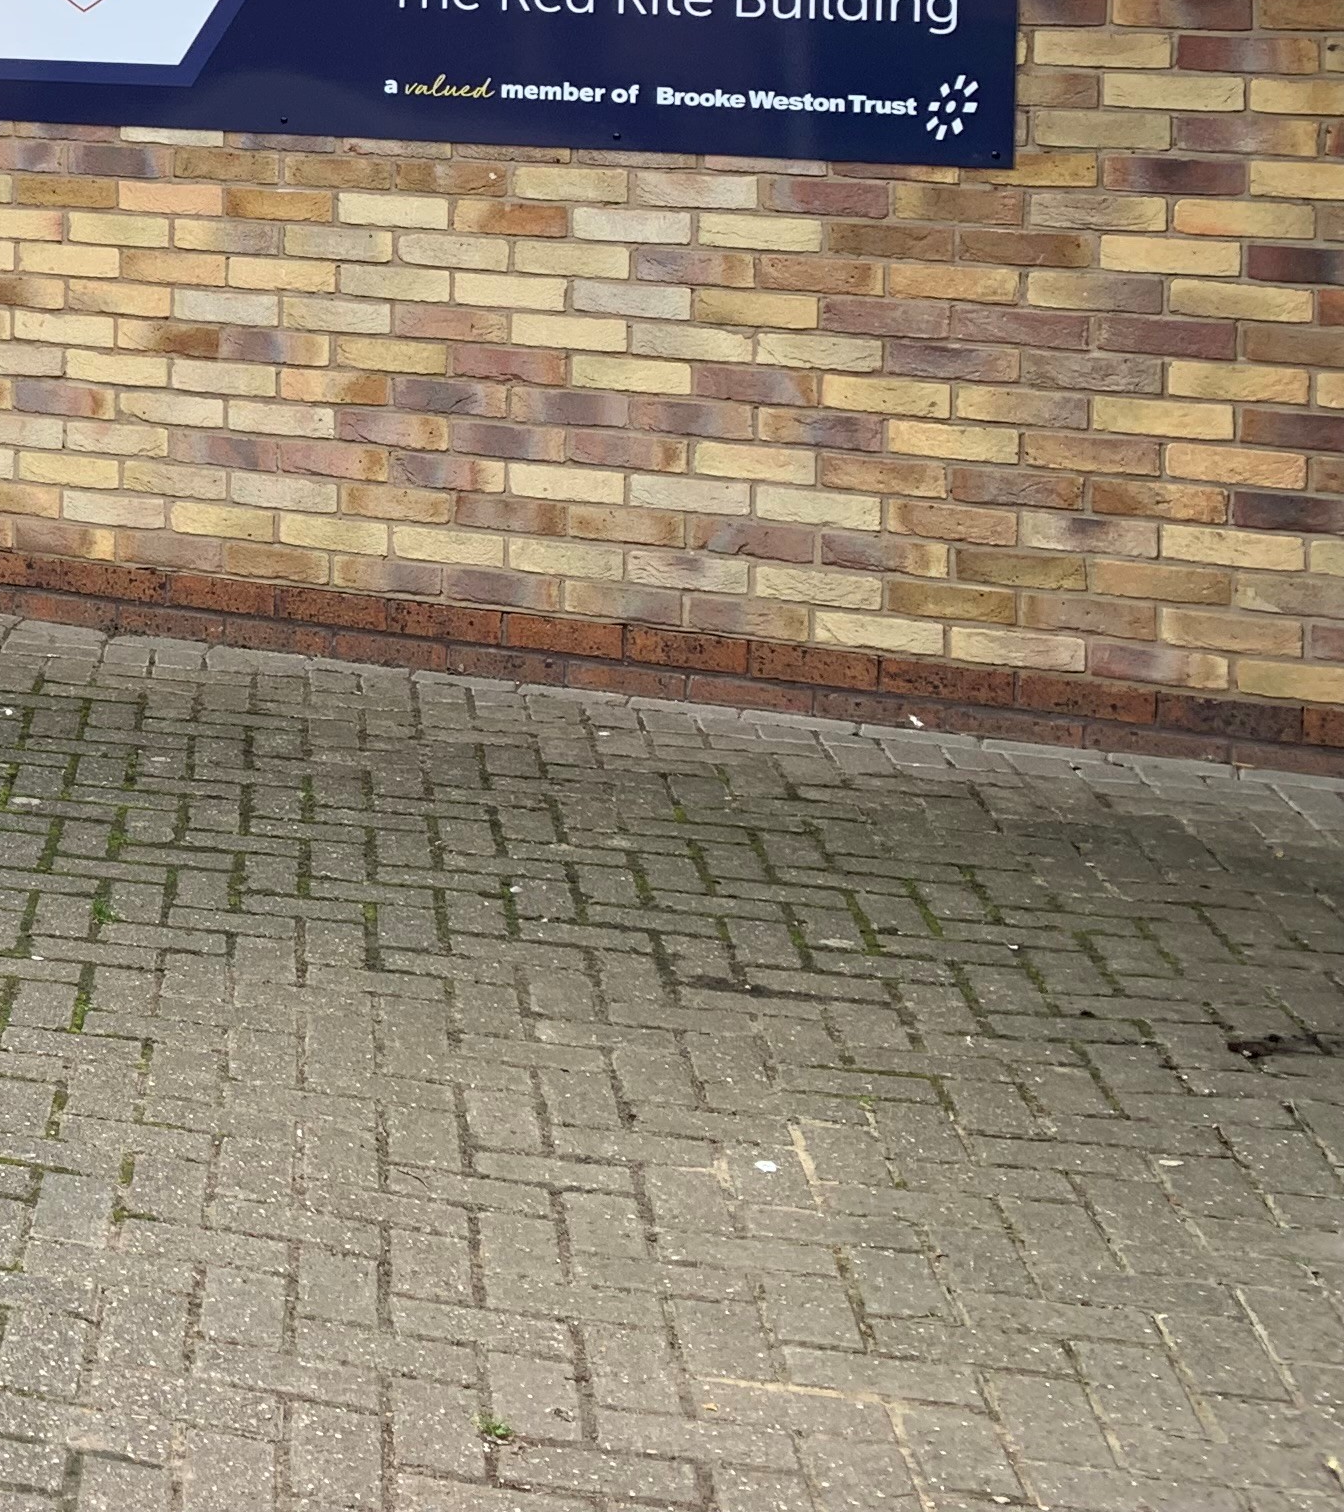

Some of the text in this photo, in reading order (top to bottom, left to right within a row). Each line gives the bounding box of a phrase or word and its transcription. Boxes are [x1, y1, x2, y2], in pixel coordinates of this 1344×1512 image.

[384, 73, 640, 104] a valued member of
[656, 86, 918, 116] Brooke Weston Trust
